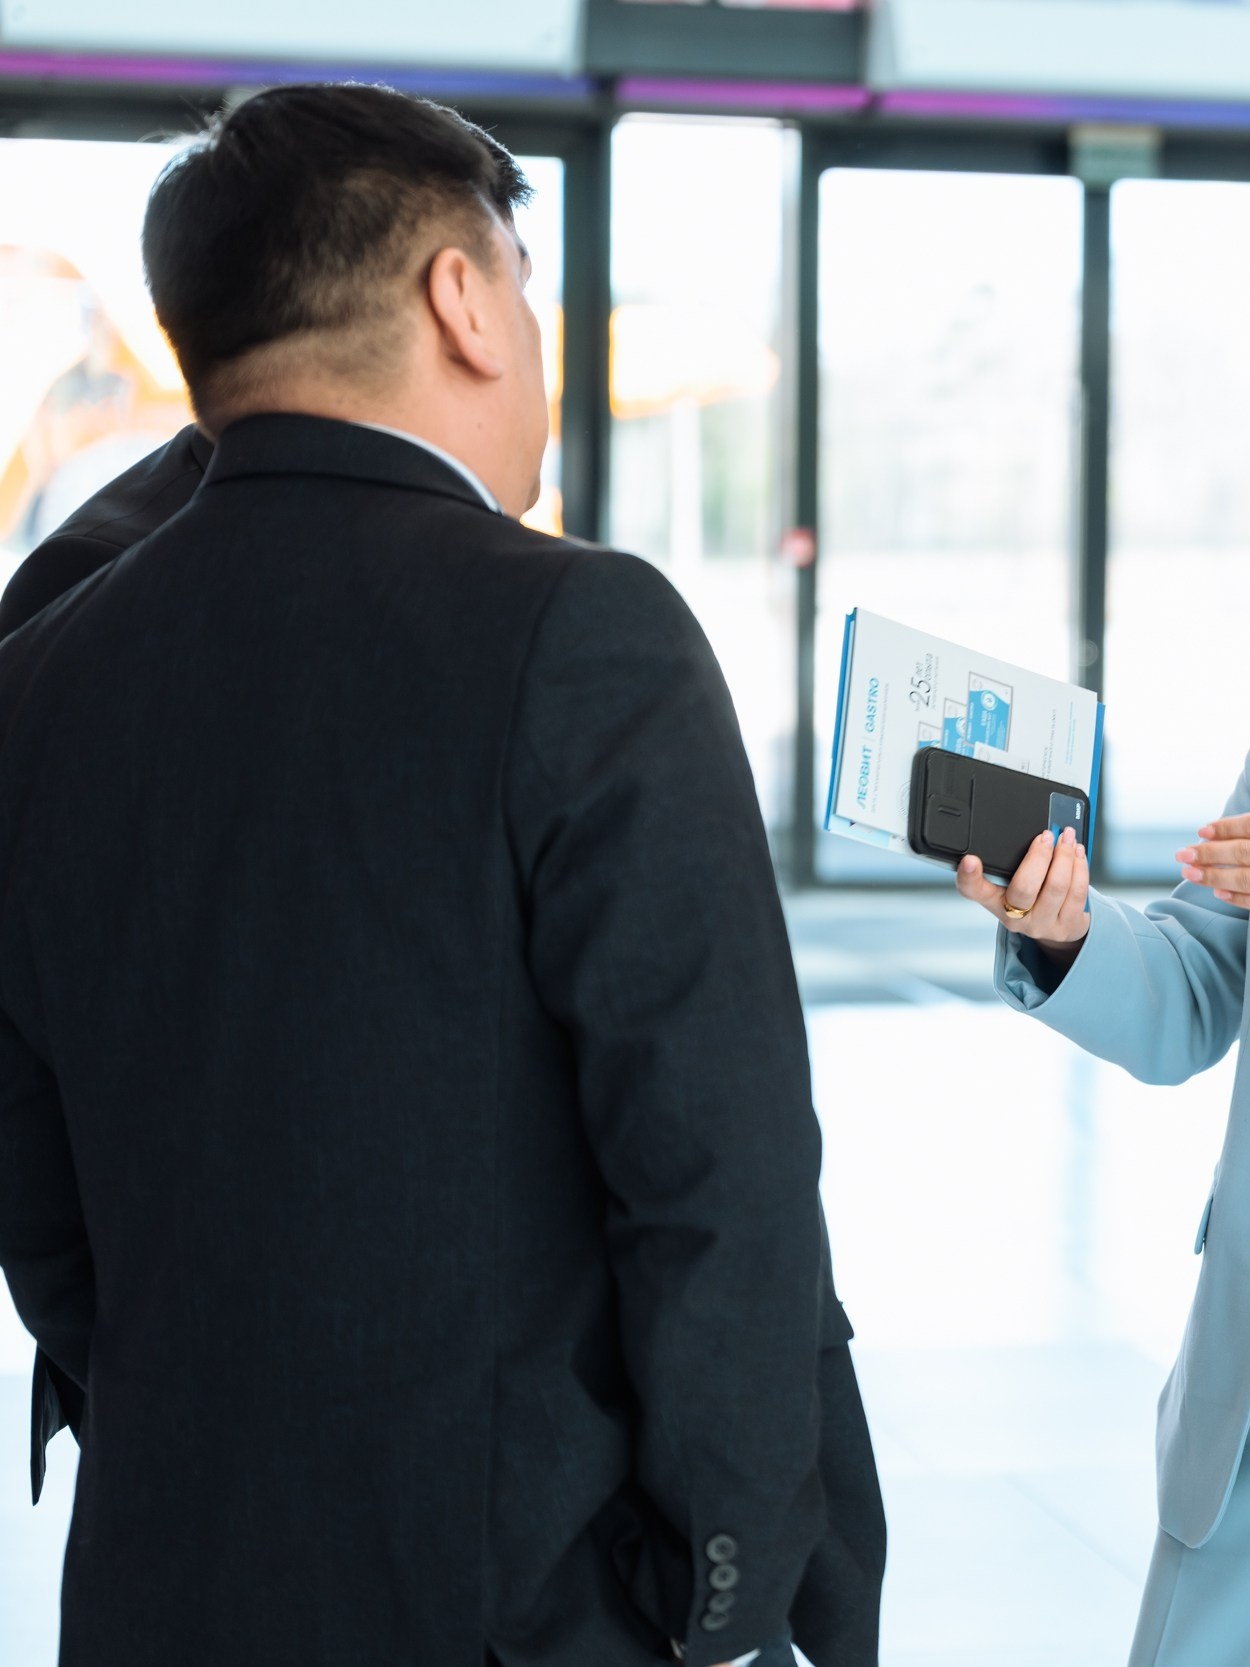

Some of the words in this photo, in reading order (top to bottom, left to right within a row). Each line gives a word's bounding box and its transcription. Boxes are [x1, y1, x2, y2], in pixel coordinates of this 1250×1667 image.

[909, 676, 931, 707] 25
[856, 745, 873, 810] ЛЕОВИТ
[865, 677, 880, 733] GASTRO
